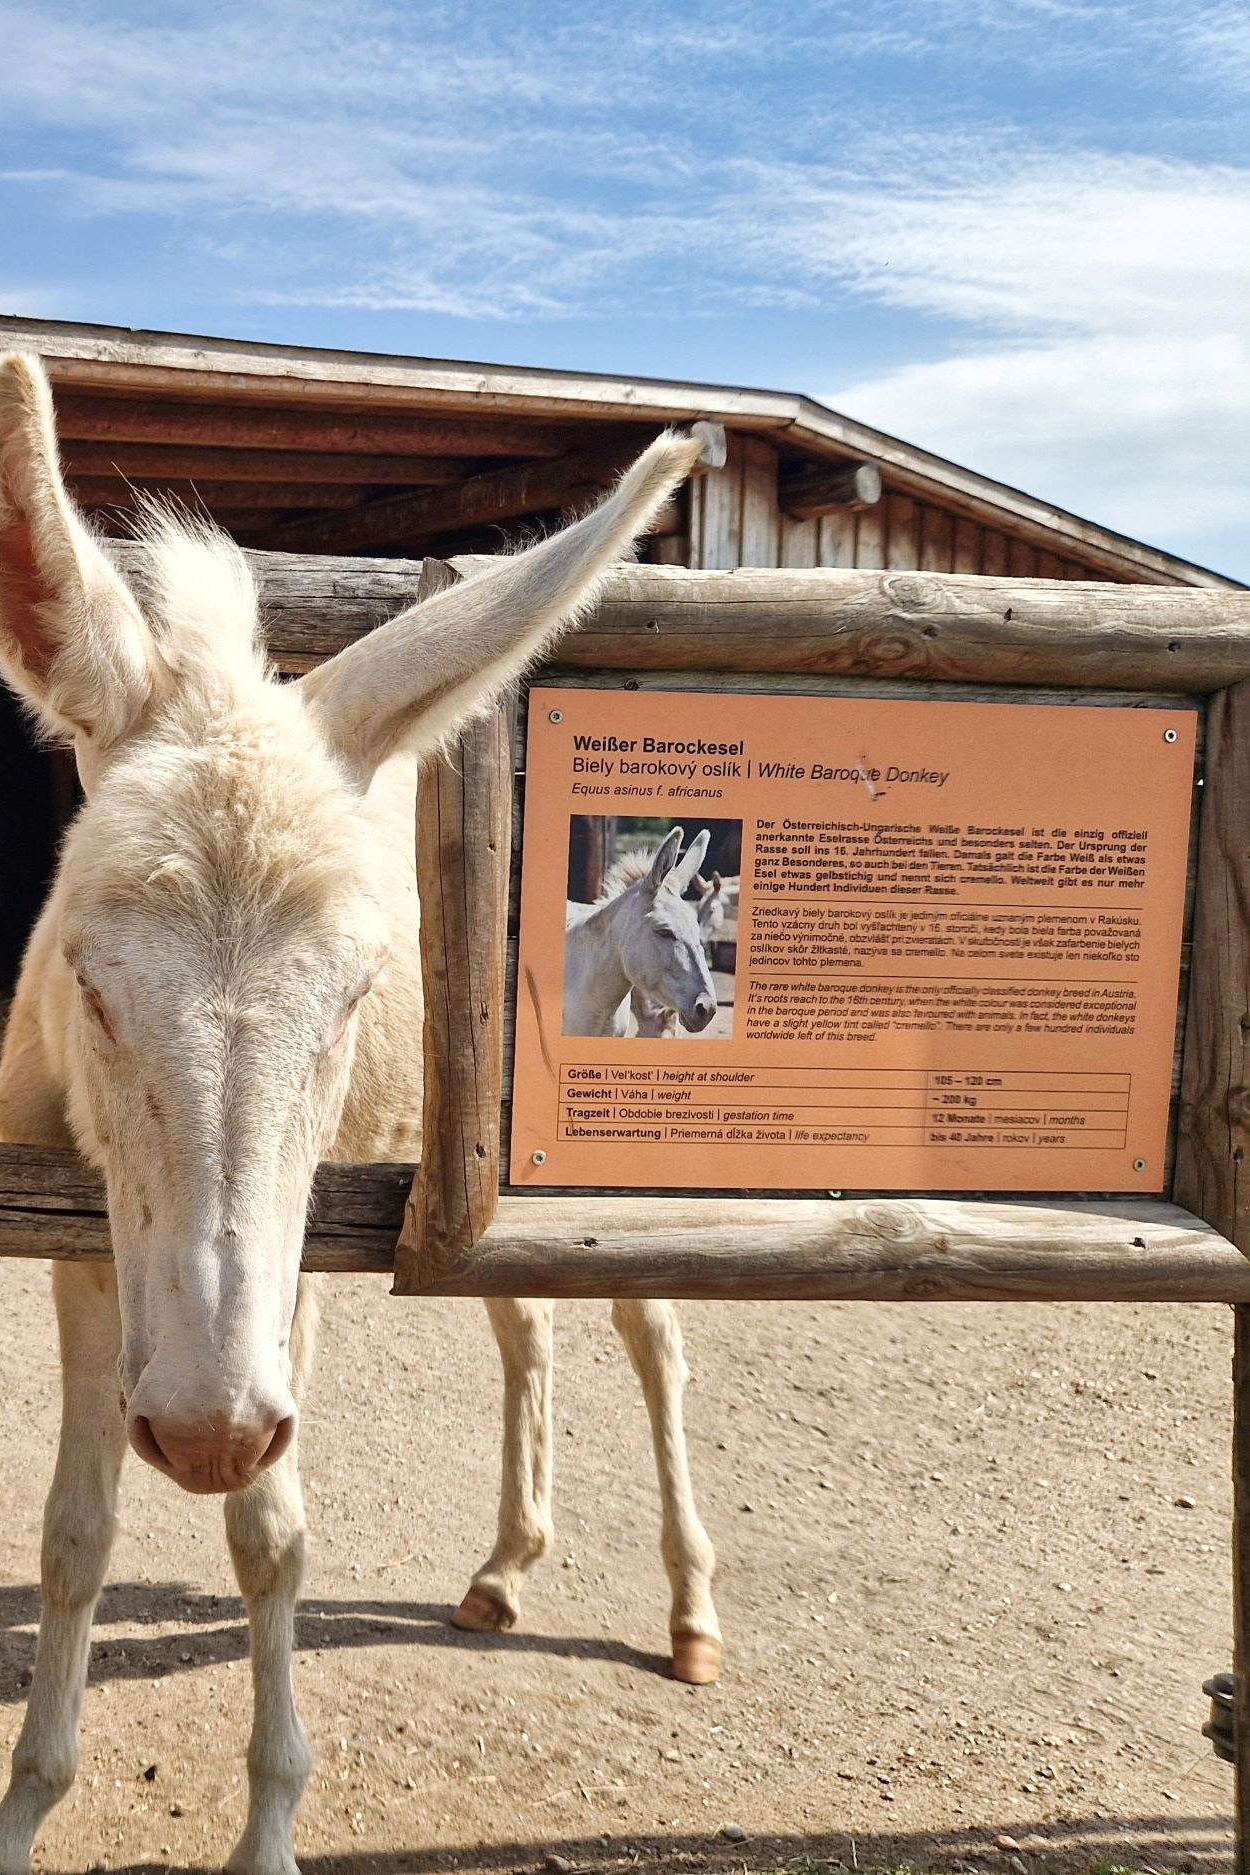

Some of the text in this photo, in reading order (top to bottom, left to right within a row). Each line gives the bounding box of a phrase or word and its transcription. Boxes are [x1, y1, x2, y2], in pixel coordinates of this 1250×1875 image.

[573, 735, 744, 755] Weißer Barockesel
[573, 757, 615, 777] Biely
[619, 758, 698, 780] barokový
[702, 761, 742, 777] oslík
[758, 763, 806, 779] White
[884, 767, 949, 787] Donkey
[572, 783, 724, 798] Equus asinus f. africanus
[757, 820, 776, 829] Der
[782, 819, 922, 835] Österreichisch-Ungarische
[1031, 828, 1044, 837] ist
[1051, 828, 1067, 837] die
[1073, 829, 1105, 840] einzig
[1111, 830, 1148, 840] offiziell
[756, 832, 815, 842] anerkannte
[818, 834, 870, 844] Eselrasse
[1056, 841, 1075, 850] Der
[1078, 842, 1127, 853] Ursprung
[1130, 843, 1147, 852] der
[755, 845, 788, 854] Rasse
[791, 845, 811, 855] soll
[814, 846, 831, 855] ins
[1017, 852, 1034, 861] die
[1036, 852, 1066, 862] Farbe
[1069, 853, 1095, 862] Weiß
[1098, 854, 1113, 863] als
[1116, 855, 1146, 864] etwas
[755, 859, 780, 868] ganz
[782, 857, 848, 869] Besonderes,
[864, 860, 890, 869] auch
[1026, 864, 1040, 873] ist
[1041, 864, 1057, 873] die
[1058, 865, 1088, 874] Farbe
[1089, 866, 1107, 875] der
[1108, 866, 1145, 876] Weißen
[753, 881, 786, 893] einige
[788, 882, 831, 892] Hundert
[833, 883, 888, 893] Individuen
[754, 869, 777, 878] Esel
[781, 871, 812, 879] etwas
[815, 871, 874, 883] gelbstichig
[877, 872, 897, 881] und
[1057, 877, 1078, 888] gibt
[1118, 879, 1144, 888] mehr
[752, 907, 800, 919] Zriedkavý
[802, 908, 825, 920] biely
[827, 909, 872, 921] barokový
[1097, 915, 1142, 925] Rakúsku.
[753, 920, 779, 929] Tento
[781, 920, 816, 932] vzácny
[818, 921, 841, 930] druh
[843, 921, 858, 930] bol
[1057, 927, 1082, 936] farba
[1083, 927, 1141, 939] považovaná
[764, 932, 791, 941] niečo
[1056, 939, 1106, 948] zafarbenie
[1107, 940, 1140, 951] bielych
[750, 944, 785, 953] oslíkov
[787, 945, 808, 954] skôr
[1082, 951, 1123, 961] niekoľko
[1125, 953, 1139, 961] sto
[749, 956, 790, 968] jedincov
[792, 957, 818, 966] tohto
[749, 982, 768, 990] The
[790, 982, 817, 991] white
[817, 983, 858, 994] baroque
[859, 984, 895, 995] donkey
[1062, 988, 1091, 997] breed
[1091, 989, 1101, 997] in
[1101, 989, 1136, 998] Austria.
[748, 994, 1137, 1012] It's roots reach to the exceptional
[747, 1006, 756, 1015] in
[758, 1006, 774, 1015] the
[775, 1006, 816, 1018] baroque
[850, 1008, 869, 1017] and
[1096, 1013, 1135, 1024] donkeys
[746, 1018, 771, 1027] have
[782, 1019, 809, 1030] slight
[810, 1019, 842, 1030] yellow
[843, 1020, 859, 1029] tint
[1085, 1024, 1134, 1034] individuals
[746, 1030, 795, 1040] worldwide
[797, 1031, 813, 1040] left
[815, 1031, 825, 1040] of
[826, 1032, 845, 1040] this
[568, 1069, 755, 1083] Größe height at shoulder
[567, 1089, 692, 1102] Gewicht Váha weight
[566, 1108, 795, 1122] Tragzeit Obdobie brezivosti gestation time
[1049, 1115, 1086, 1125] months
[565, 1128, 870, 1143] Lebenserwartung Priemerná dĺžka života life expectancy
[1037, 1136, 1065, 1145] years
